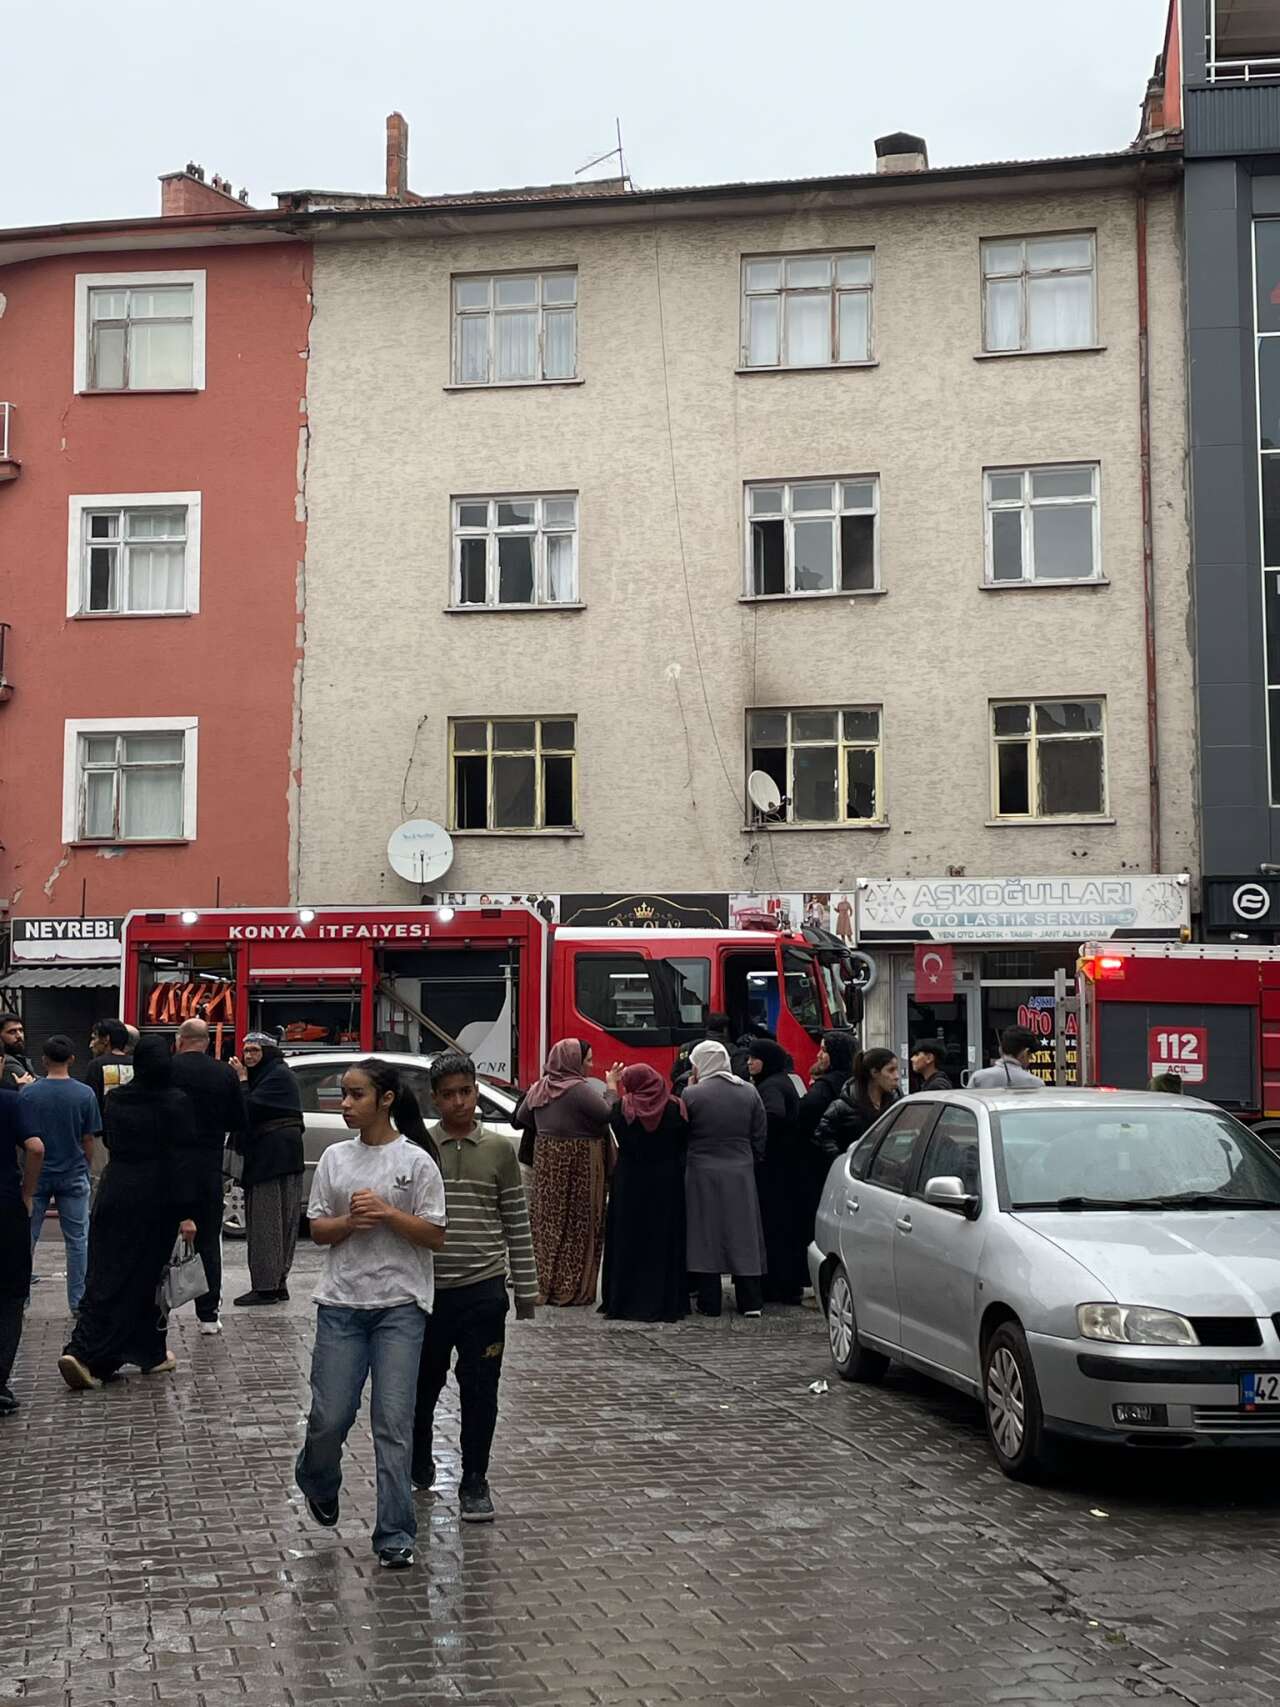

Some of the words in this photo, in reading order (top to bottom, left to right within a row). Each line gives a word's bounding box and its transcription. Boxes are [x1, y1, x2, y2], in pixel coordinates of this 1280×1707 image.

[920, 914, 959, 926] OTO
[229, 926, 306, 939] KONYA
[1157, 1033, 1198, 1059] 112
[1256, 1376, 1279, 1400] 42
